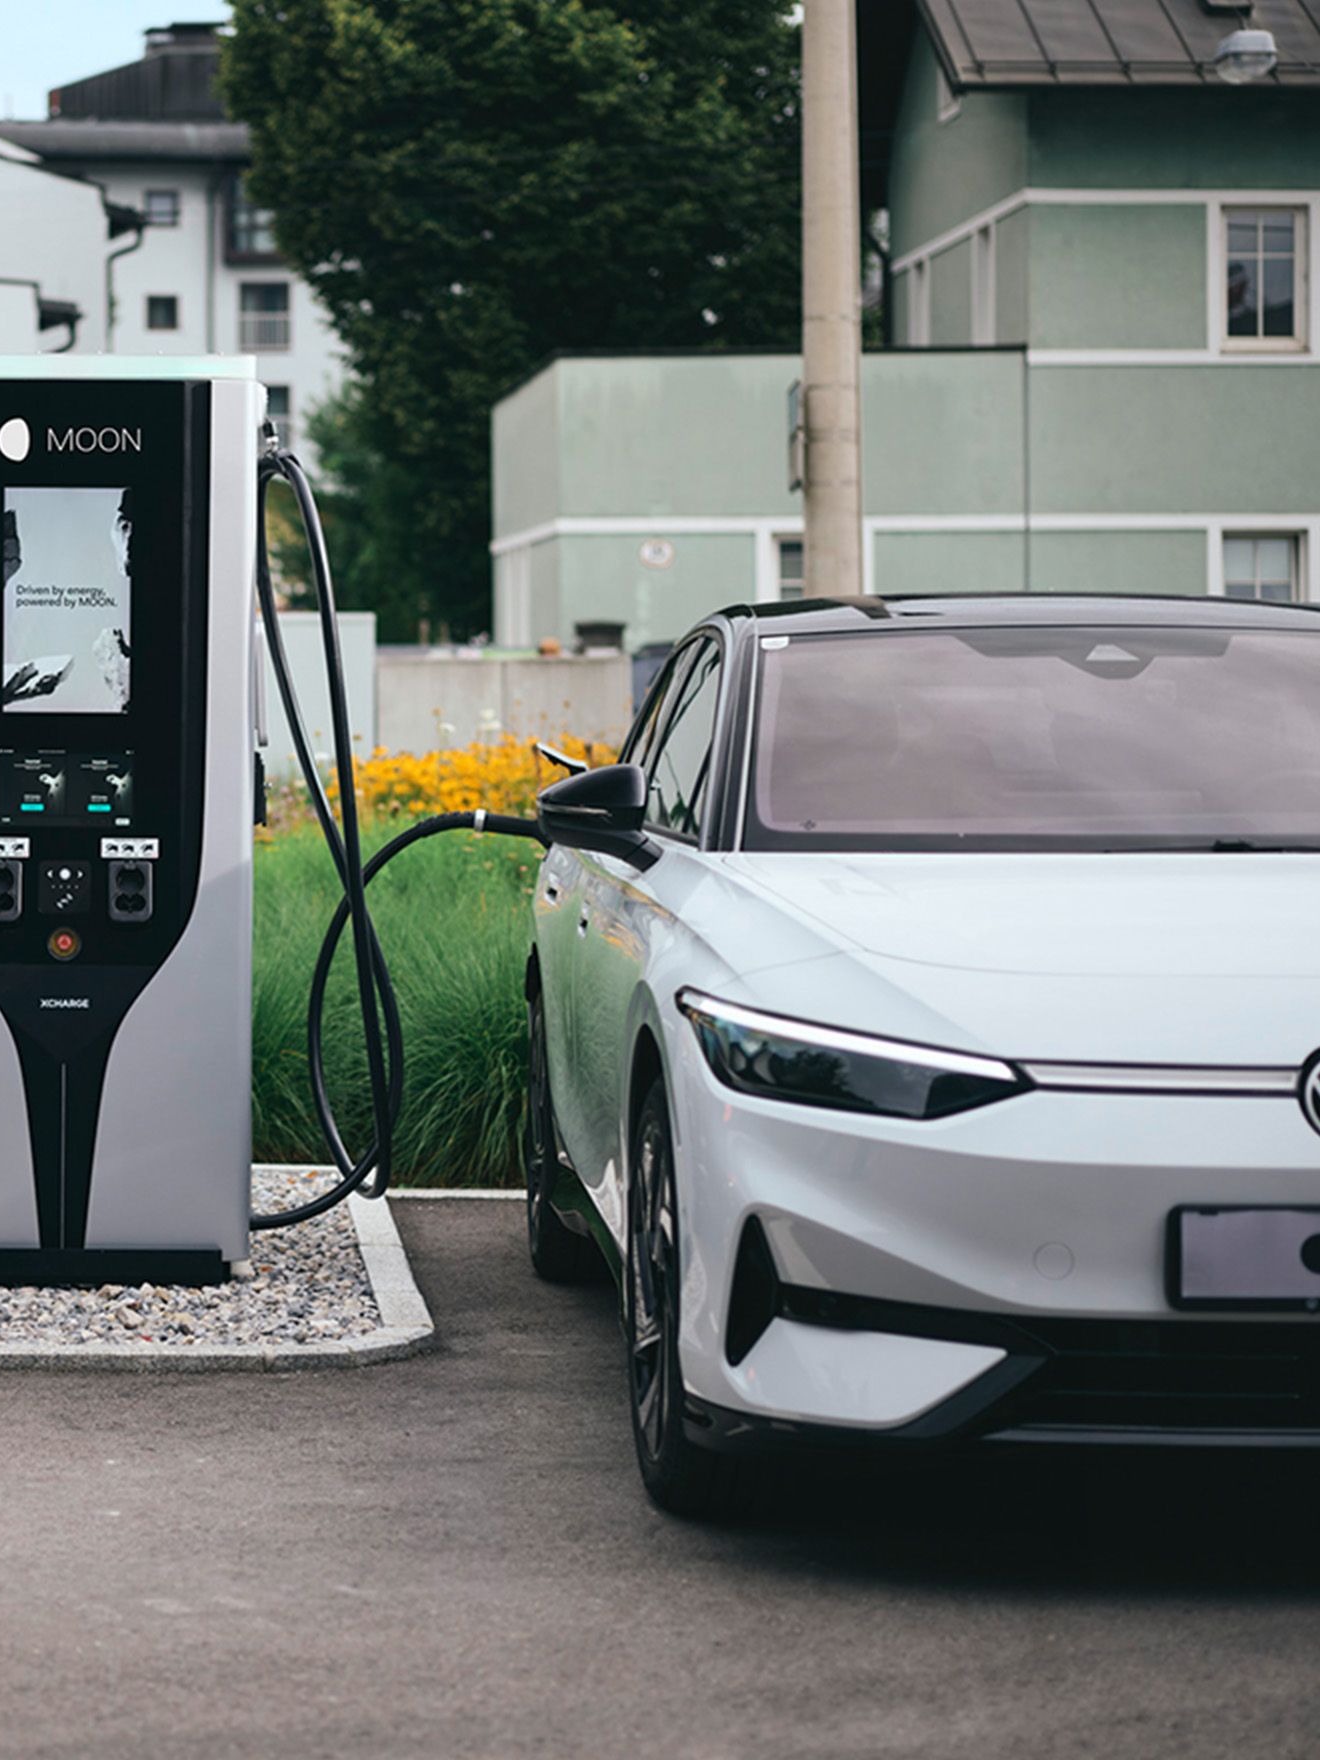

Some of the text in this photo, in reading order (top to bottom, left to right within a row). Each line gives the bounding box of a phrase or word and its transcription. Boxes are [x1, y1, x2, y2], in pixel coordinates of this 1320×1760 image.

[47, 427, 141, 452] MOON
[15, 585, 106, 600] Driven by energy,
[16, 597, 118, 609] powered by MOON.
[40, 998, 89, 1008] XCHARGE
